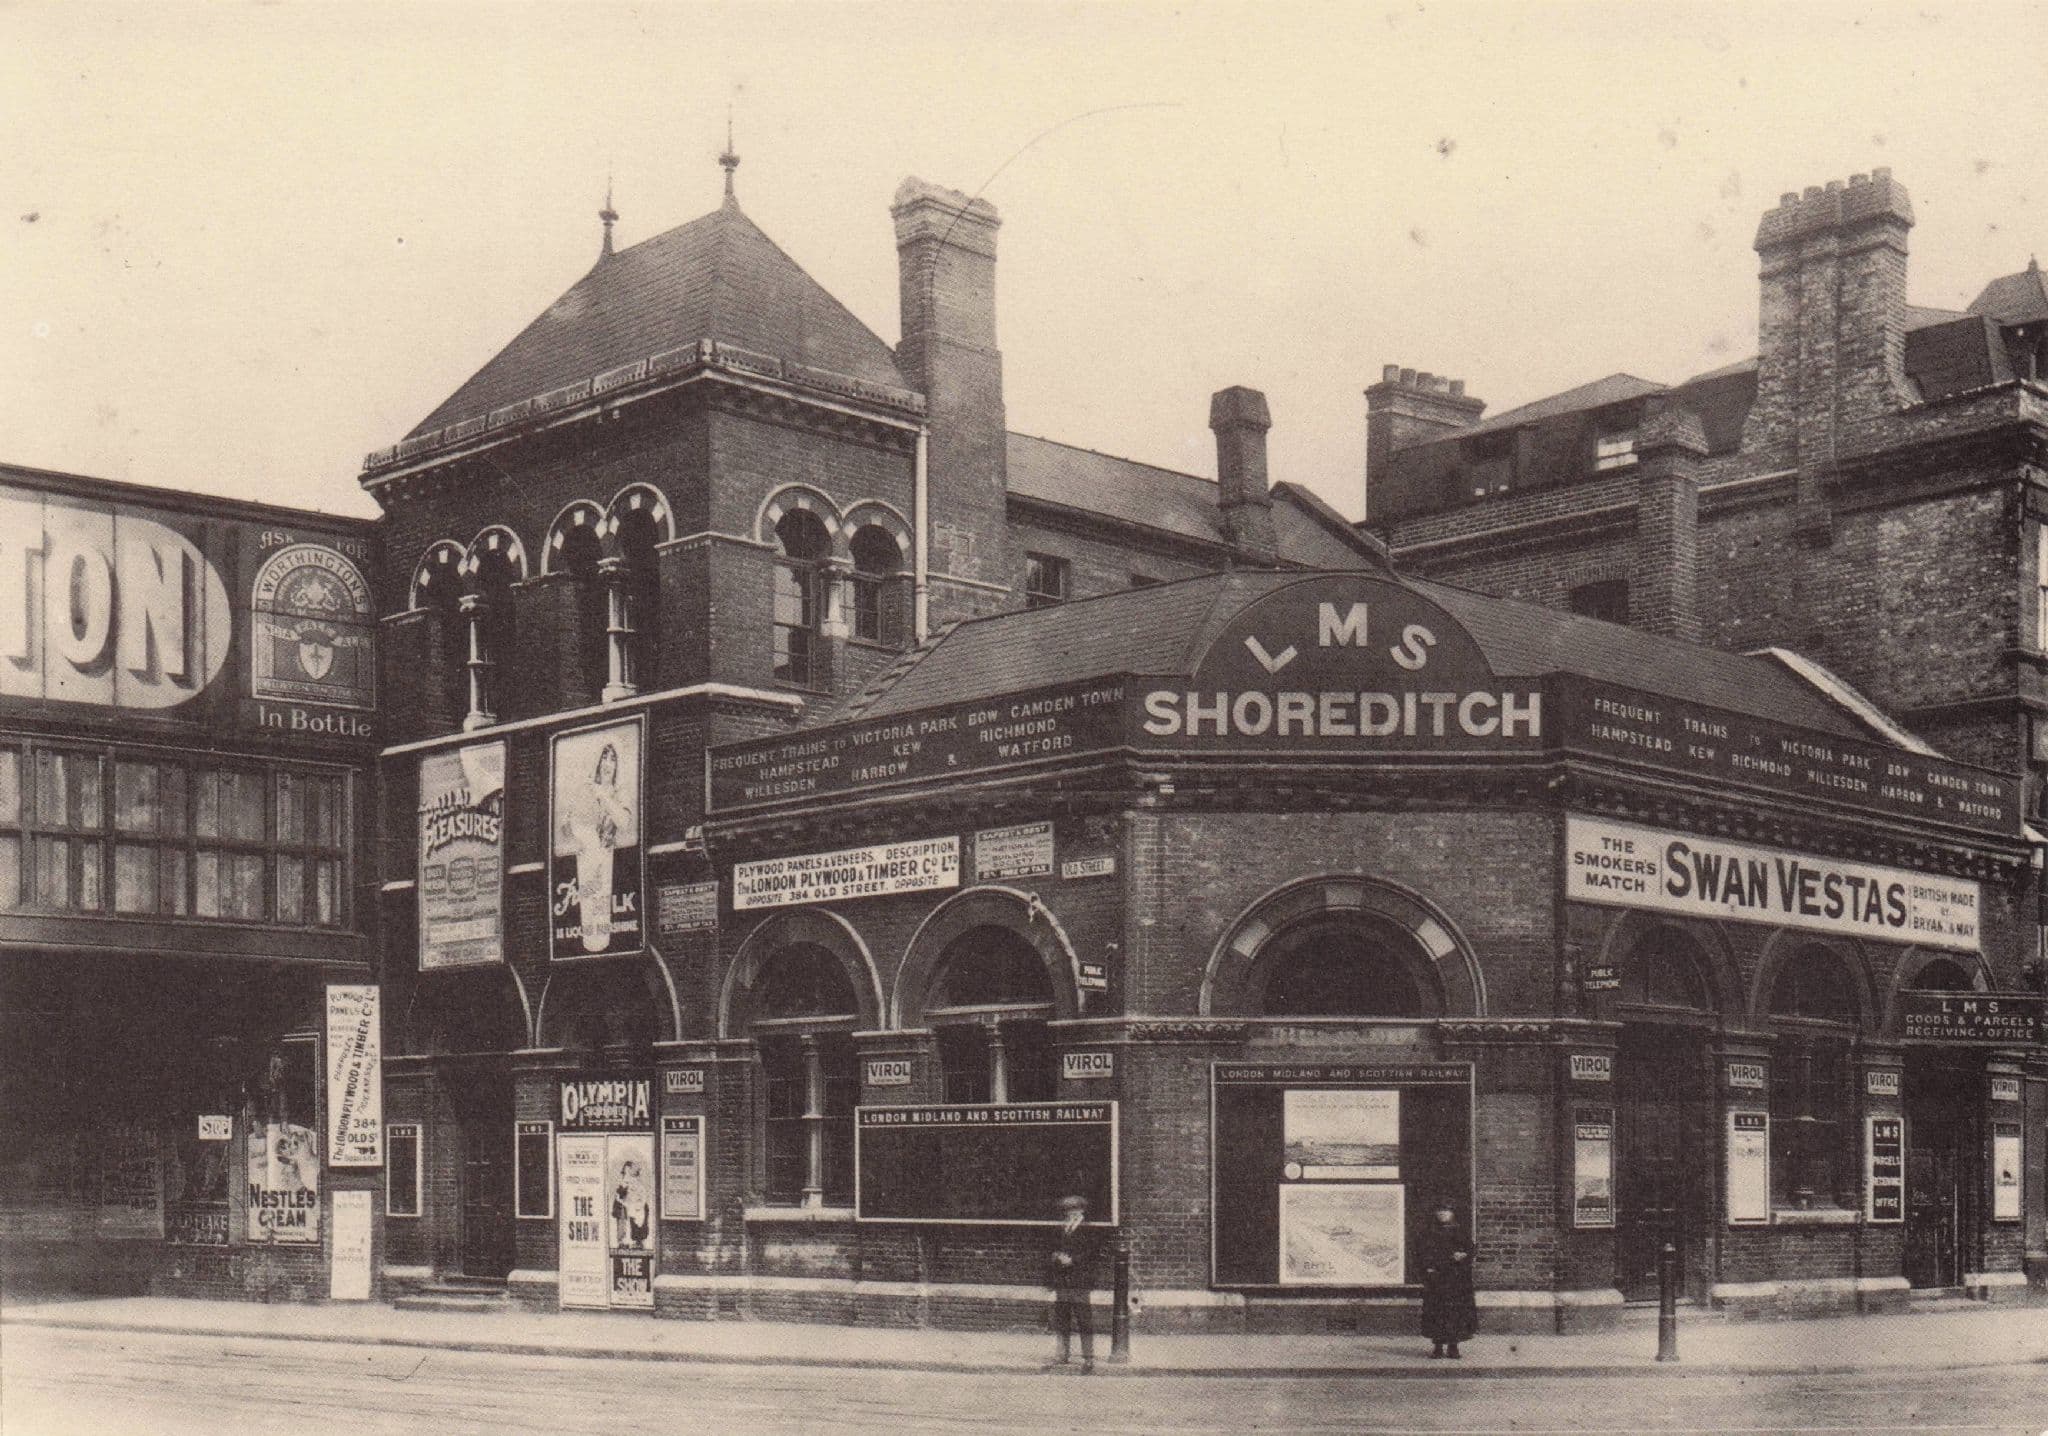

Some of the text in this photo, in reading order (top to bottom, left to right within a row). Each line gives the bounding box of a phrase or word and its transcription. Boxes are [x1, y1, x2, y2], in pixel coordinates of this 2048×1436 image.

[259, 705, 372, 738] In Bottle
[1143, 690, 1541, 738] SHOREDITCH
[713, 751, 776, 771] FREQUENT
[782, 740, 827, 759] TRAINS
[853, 722, 915, 746] VICTORIA
[920, 716, 957, 734] PARK
[968, 709, 998, 726] BOW
[1010, 696, 1075, 719] CAMDEN
[1081, 687, 1125, 706] TOWN
[760, 718, 1057, 780] HAMPSTEAD KEW RICHMOND
[1594, 698, 1662, 725] FREQUENT
[1684, 718, 1729, 739] TRAINS
[1781, 740, 1833, 762] VICTORIA
[1843, 754, 1871, 770] PARK
[1888, 763, 1910, 778] BOW
[1927, 772, 1968, 792] CAMDEN
[1975, 782, 2001, 797] TOWN
[744, 735, 1072, 799] WILLESDEN HARROW & WATFORD
[1591, 723, 1672, 752] HAMPSTEAD
[1688, 743, 1715, 761] KEW
[1731, 753, 1792, 777] RICHMOND
[1807, 769, 1868, 793] WILLESDEN
[1881, 785, 1924, 804] HARROW
[1958, 801, 2002, 820] WATFORD
[422, 812, 501, 852] PLEASURES
[1601, 837, 1635, 854] THE
[738, 862, 784, 878] PLYWOOD
[787, 859, 822, 872] PANELS
[886, 842, 955, 860] DESCRIPTION
[1574, 851, 1657, 875] SMOKER'S
[751, 875, 796, 894] LONDON
[800, 867, 856, 888] PLYWOOD
[866, 860, 918, 881] TIMBER
[814, 886, 837, 898] OLD
[894, 874, 939, 889] OPPOSITE
[1585, 873, 1645, 893] MATCH
[1666, 841, 1907, 928] SWAN VESTAS
[1913, 886, 1975, 908] BRITISH MADE
[1956, 923, 1975, 937] MAY
[1906, 1014, 2035, 1027] GOODS & PARCELS
[352, 1019, 371, 1059] TIMBER
[1906, 1026, 2034, 1039] RECEIVING OFFICE
[869, 1063, 910, 1077] VIROL
[1067, 1054, 1111, 1070] VIROL
[1573, 1056, 1610, 1073] VIROL
[667, 1071, 702, 1086] VIROL
[1220, 1069, 1464, 1079] LONDON MIDLAND AND SCOTTISH RAILWAY
[1731, 1065, 1763, 1080] VIROL
[1869, 1074, 1898, 1087] VIROL
[342, 1069, 360, 1113] PLYWOOD
[1993, 1081, 2018, 1093] VIROL
[562, 1082, 650, 1122] OLYMPIA
[353, 1118, 377, 1129] 384
[864, 1107, 1104, 1123] LONDON MIDLAND AND SCOTTISH RAILWAY
[336, 1113, 351, 1147] LONDON
[347, 1133, 367, 1143] OLD
[250, 1183, 316, 1209] NESTLE'S
[1874, 1197, 1898, 1208] OFFICE
[573, 1196, 593, 1217] THE
[258, 1209, 306, 1228] CREAM
[568, 1221, 599, 1241] SHOW
[622, 1257, 643, 1276] THE
[617, 1277, 647, 1292] SHOW
